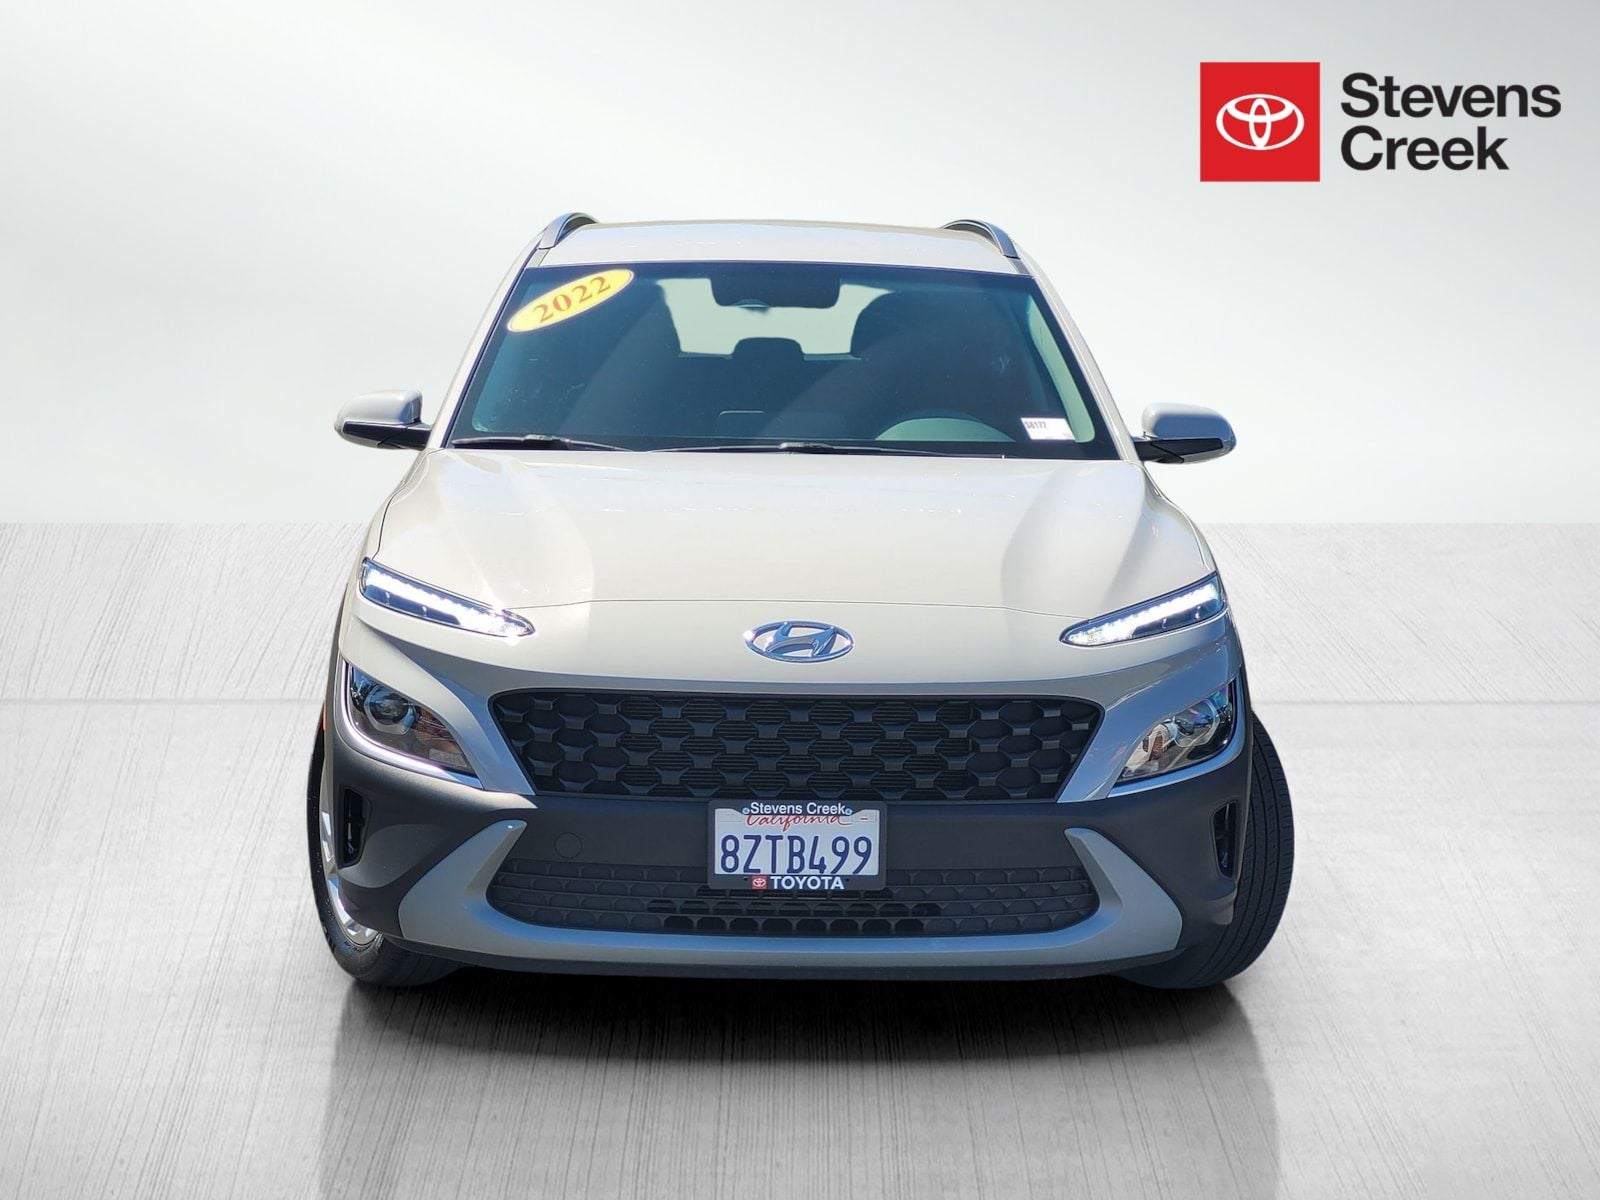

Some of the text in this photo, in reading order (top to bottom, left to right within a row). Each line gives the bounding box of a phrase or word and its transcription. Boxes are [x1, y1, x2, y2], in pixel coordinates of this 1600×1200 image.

[532, 276, 611, 323] 2022
[750, 802, 846, 815] Stevens Creek
[721, 834, 872, 875] 8ZTB499
[770, 876, 845, 890] TOYOTA
